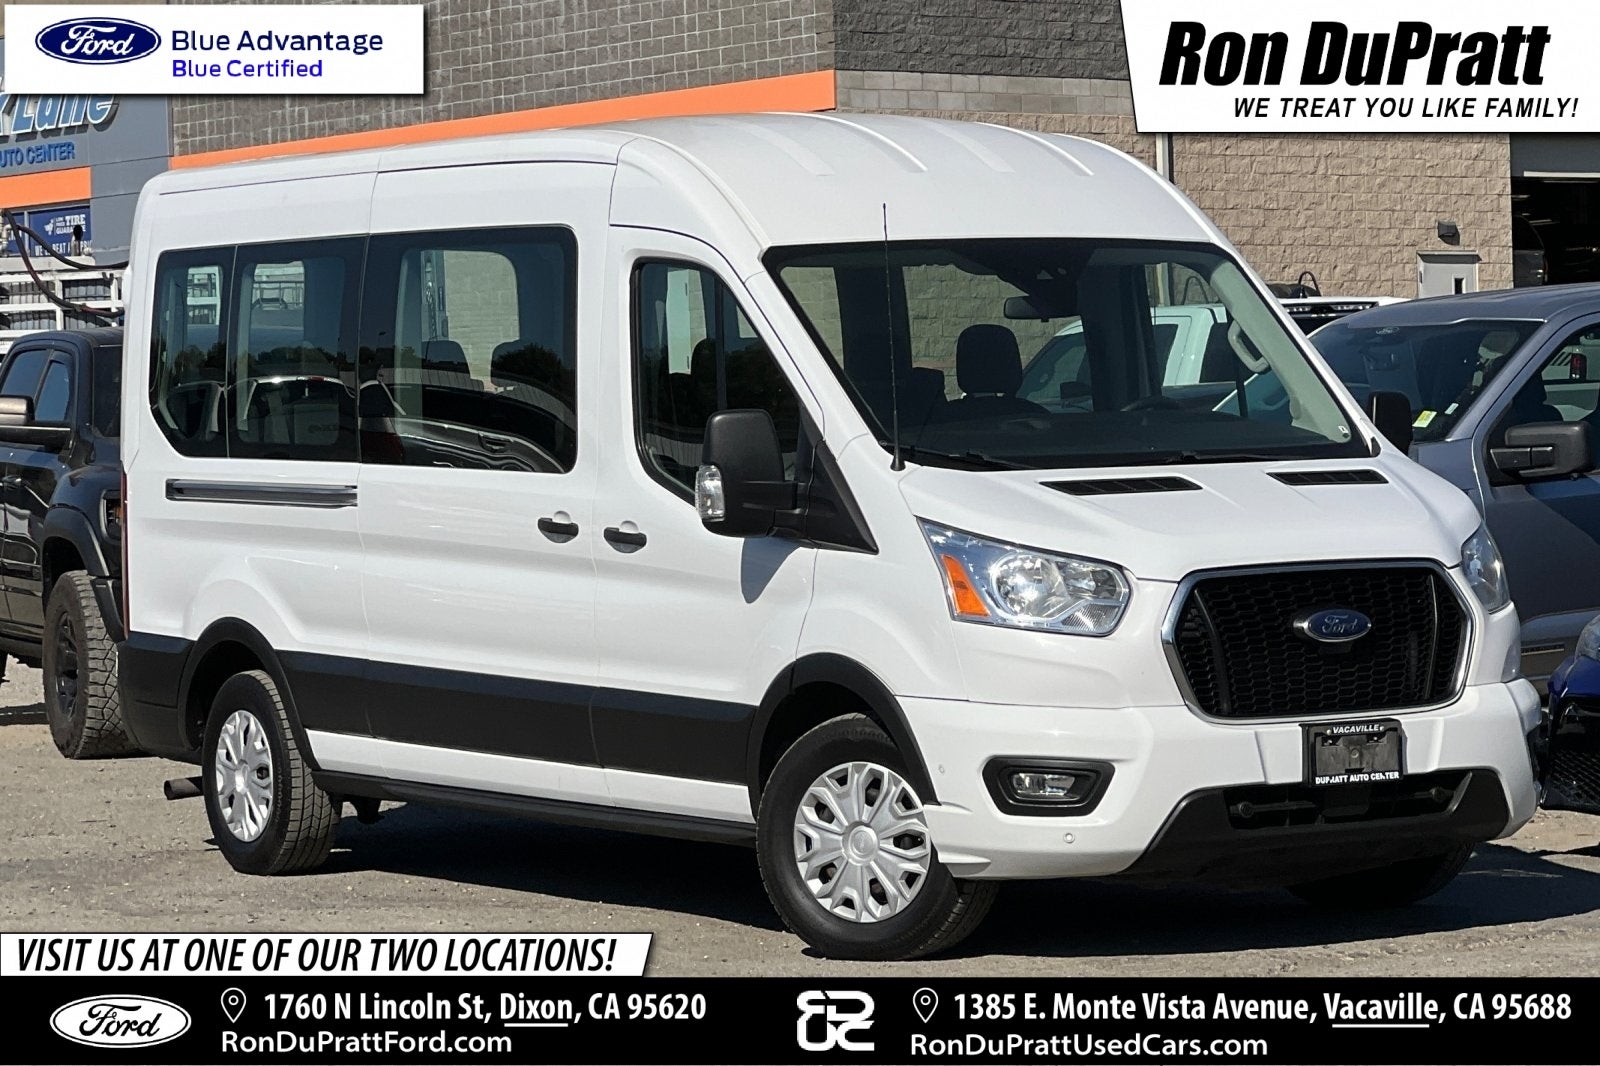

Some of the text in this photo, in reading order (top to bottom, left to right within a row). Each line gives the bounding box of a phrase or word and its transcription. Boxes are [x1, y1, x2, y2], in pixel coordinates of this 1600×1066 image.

[26, 142, 75, 165] CENTER
[65, 214, 86, 226] TIRE
[1321, 615, 1358, 633] Ford
[1333, 724, 1379, 733] VACAVILLE
[1350, 773, 1369, 782] AUTO
